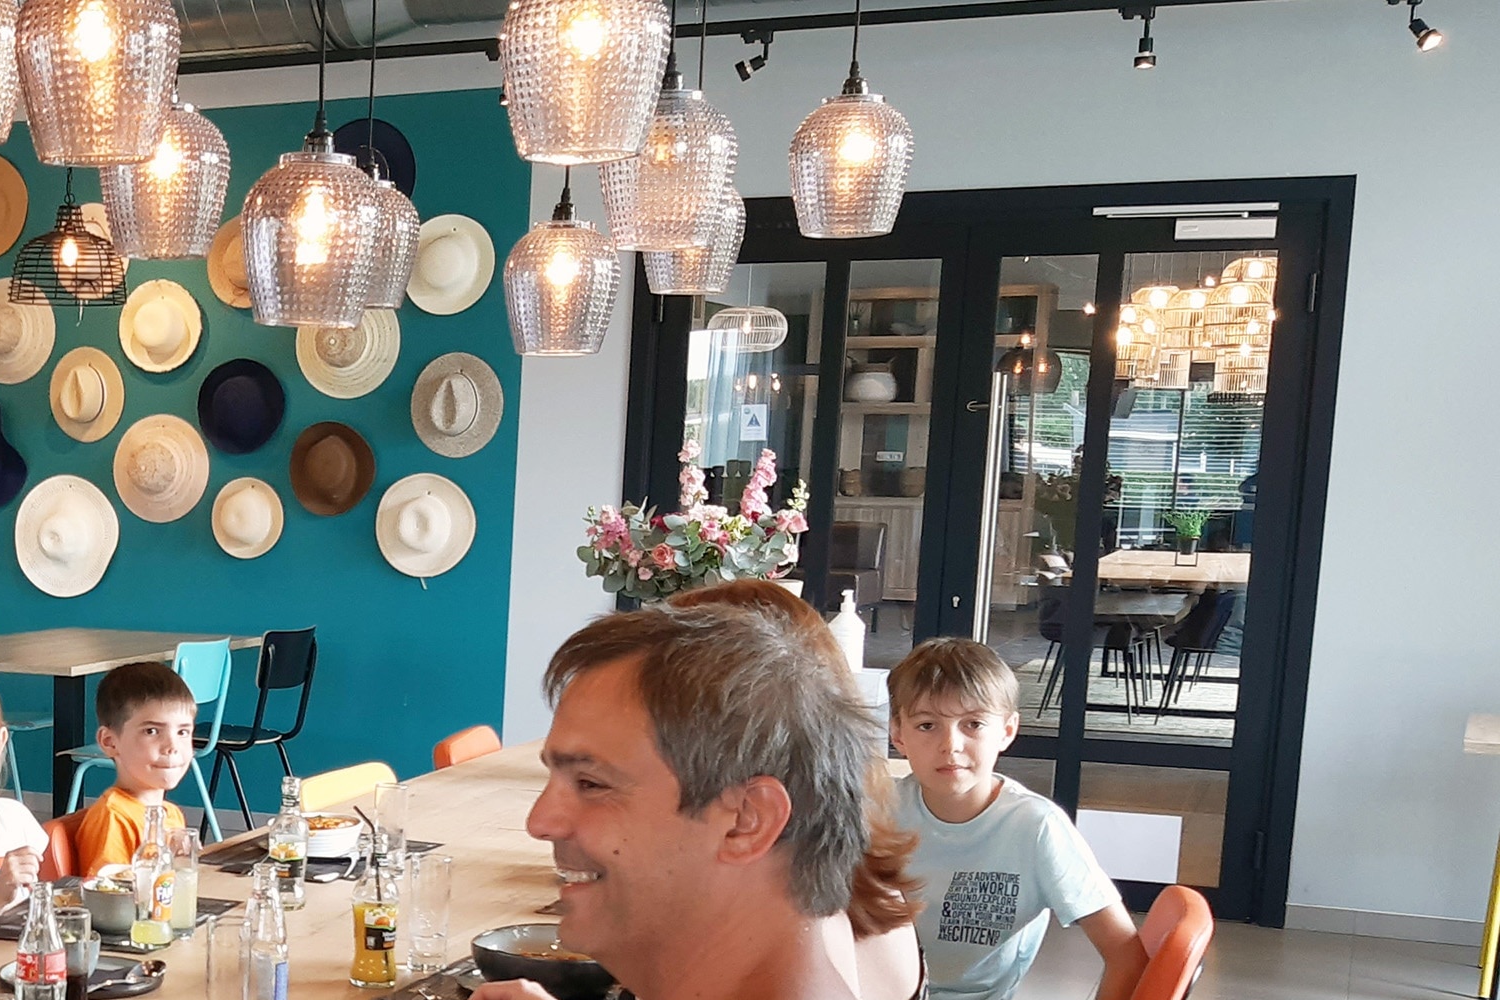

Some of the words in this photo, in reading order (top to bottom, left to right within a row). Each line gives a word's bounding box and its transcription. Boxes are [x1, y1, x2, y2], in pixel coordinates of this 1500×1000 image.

[974, 871, 1020, 884] ADVENTURE
[979, 881, 1020, 897] WORLD
[941, 901, 951, 917] &
[940, 925, 952, 934] WE
